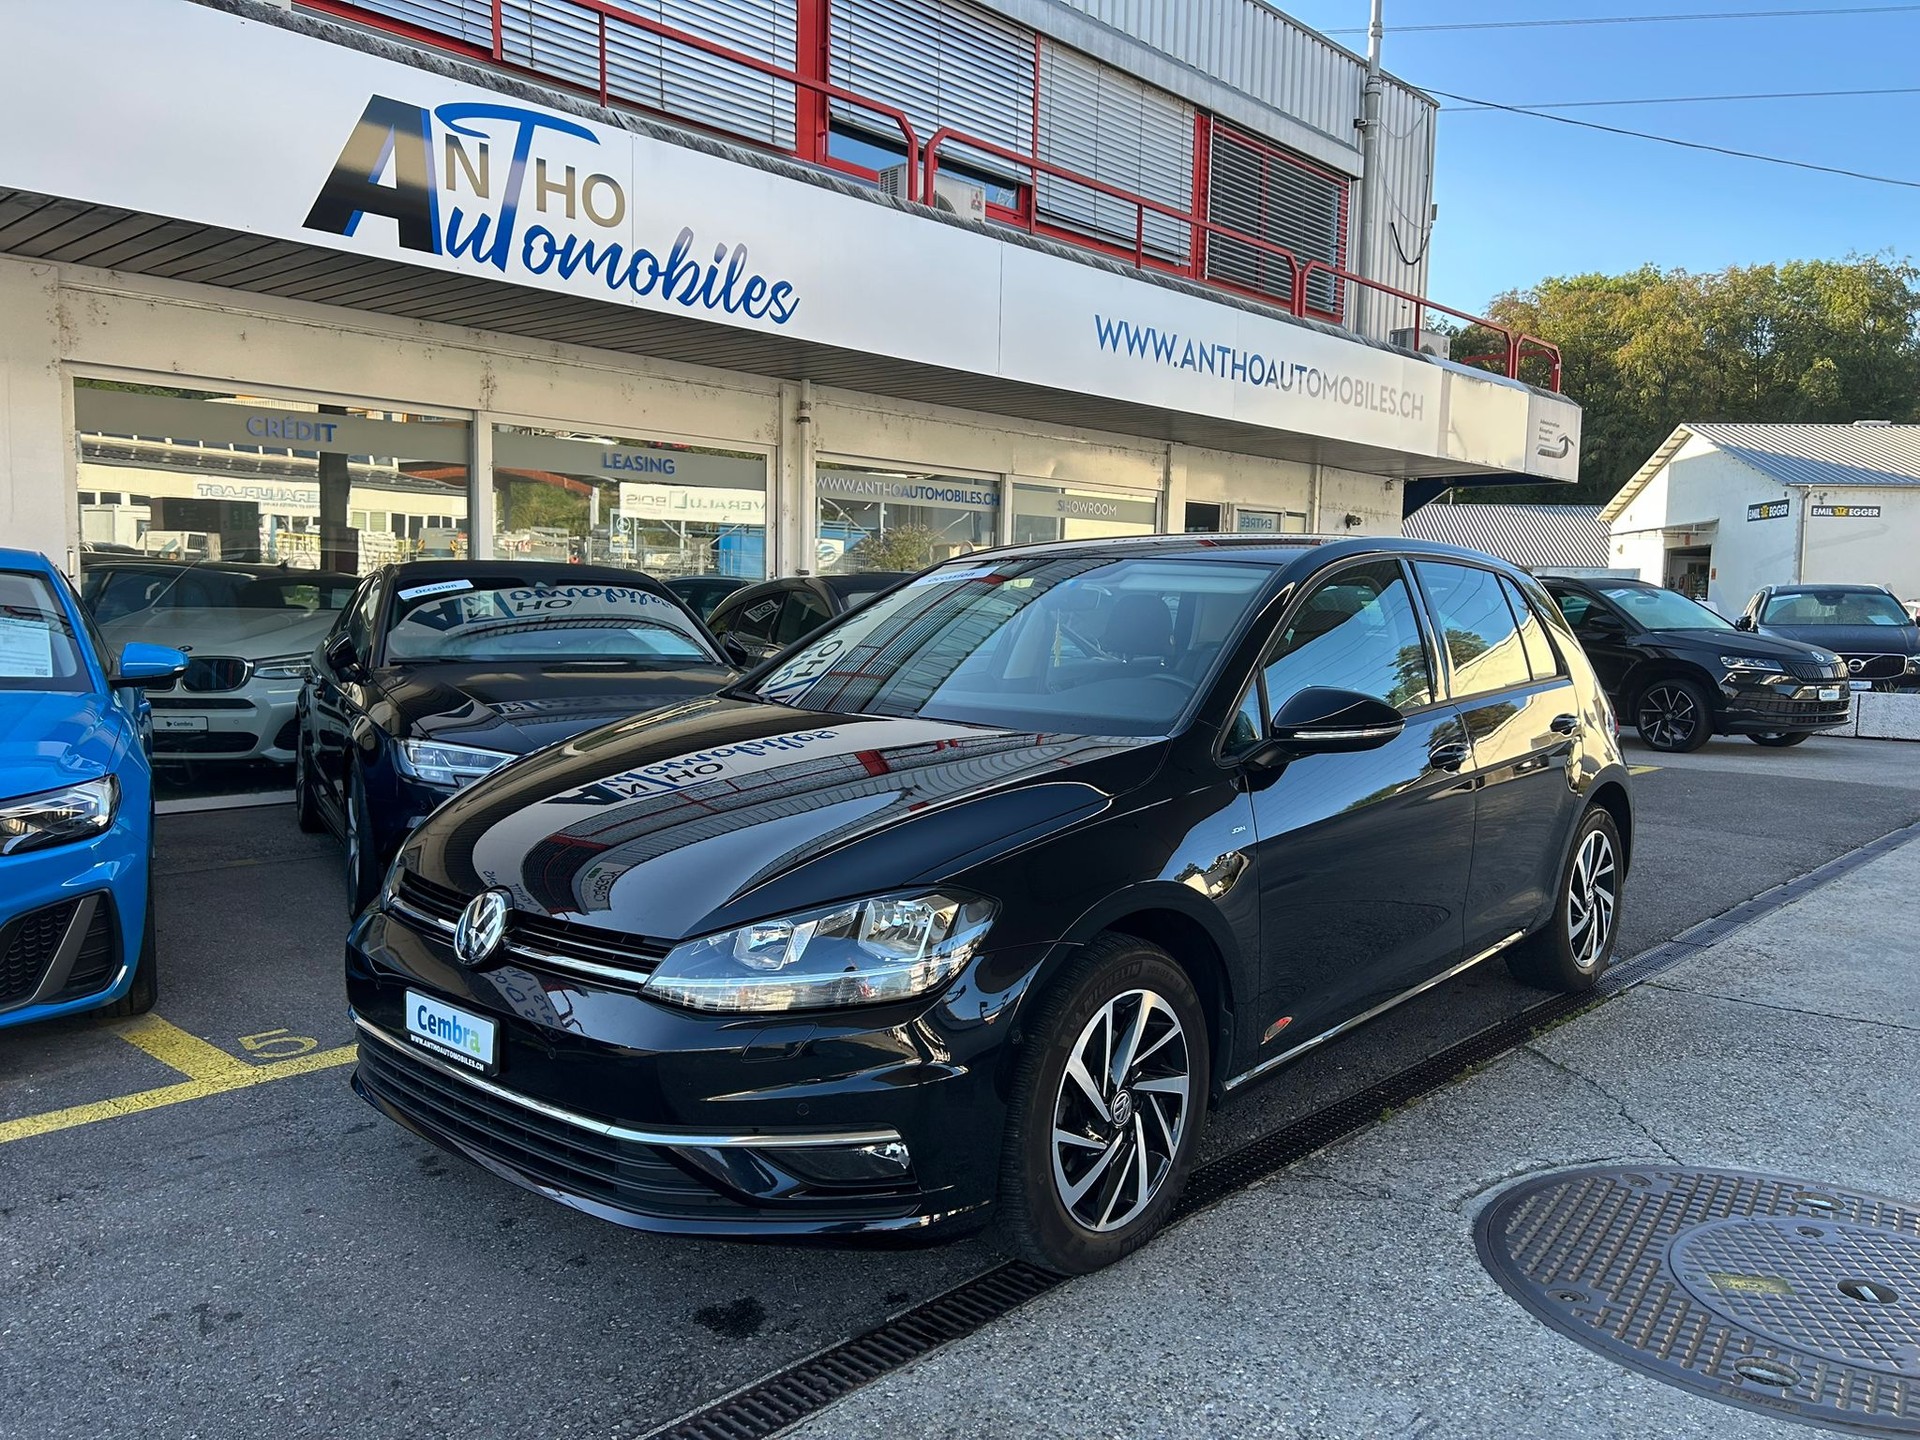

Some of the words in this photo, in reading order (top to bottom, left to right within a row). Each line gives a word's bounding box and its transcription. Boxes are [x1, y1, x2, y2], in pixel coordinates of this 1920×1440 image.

[1094, 314, 1424, 421] WWW.ANTHOAUTOMOBILES.CH
[246, 415, 338, 443] CRÉDIT
[602, 452, 676, 475] LEASING
[816, 475, 1000, 507] WWW.ANTHOAUTOMOBILES.CH
[1057, 499, 1118, 517] SHOWROOM
[1748, 508, 1760, 520] EMIL
[1769, 504, 1788, 517] EGGER
[1812, 507, 1834, 516] EMIL
[1848, 508, 1879, 517] EGGER
[415, 583, 457, 595] Occasion
[1232, 825, 1247, 835] JOIN
[417, 1004, 481, 1054] Cembra
[410, 1033, 485, 1072] WWW.ANTHOAUTOMOBILES.CH
